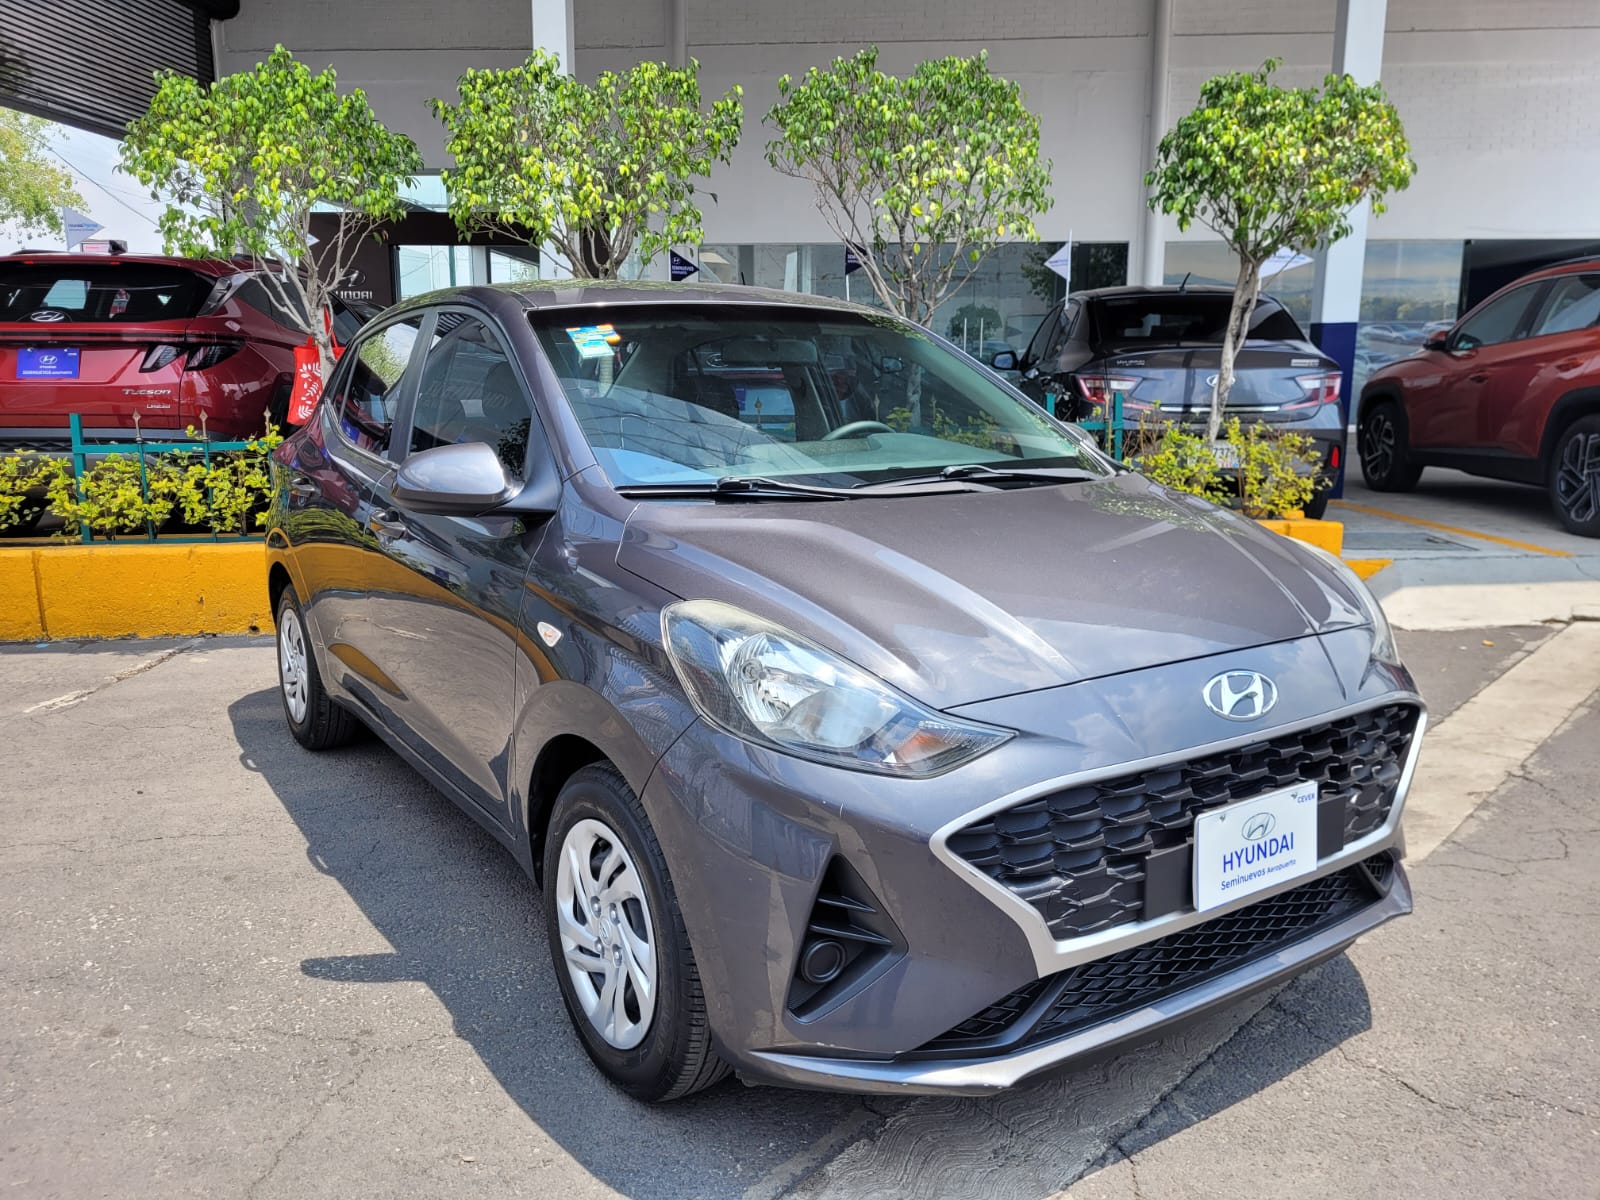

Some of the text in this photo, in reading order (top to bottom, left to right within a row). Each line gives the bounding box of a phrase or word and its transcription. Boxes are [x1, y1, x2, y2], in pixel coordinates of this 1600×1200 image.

[1222, 831, 1294, 874] HYUNDAI
[1220, 859, 1297, 891] Seminuevos Aeropuerto
